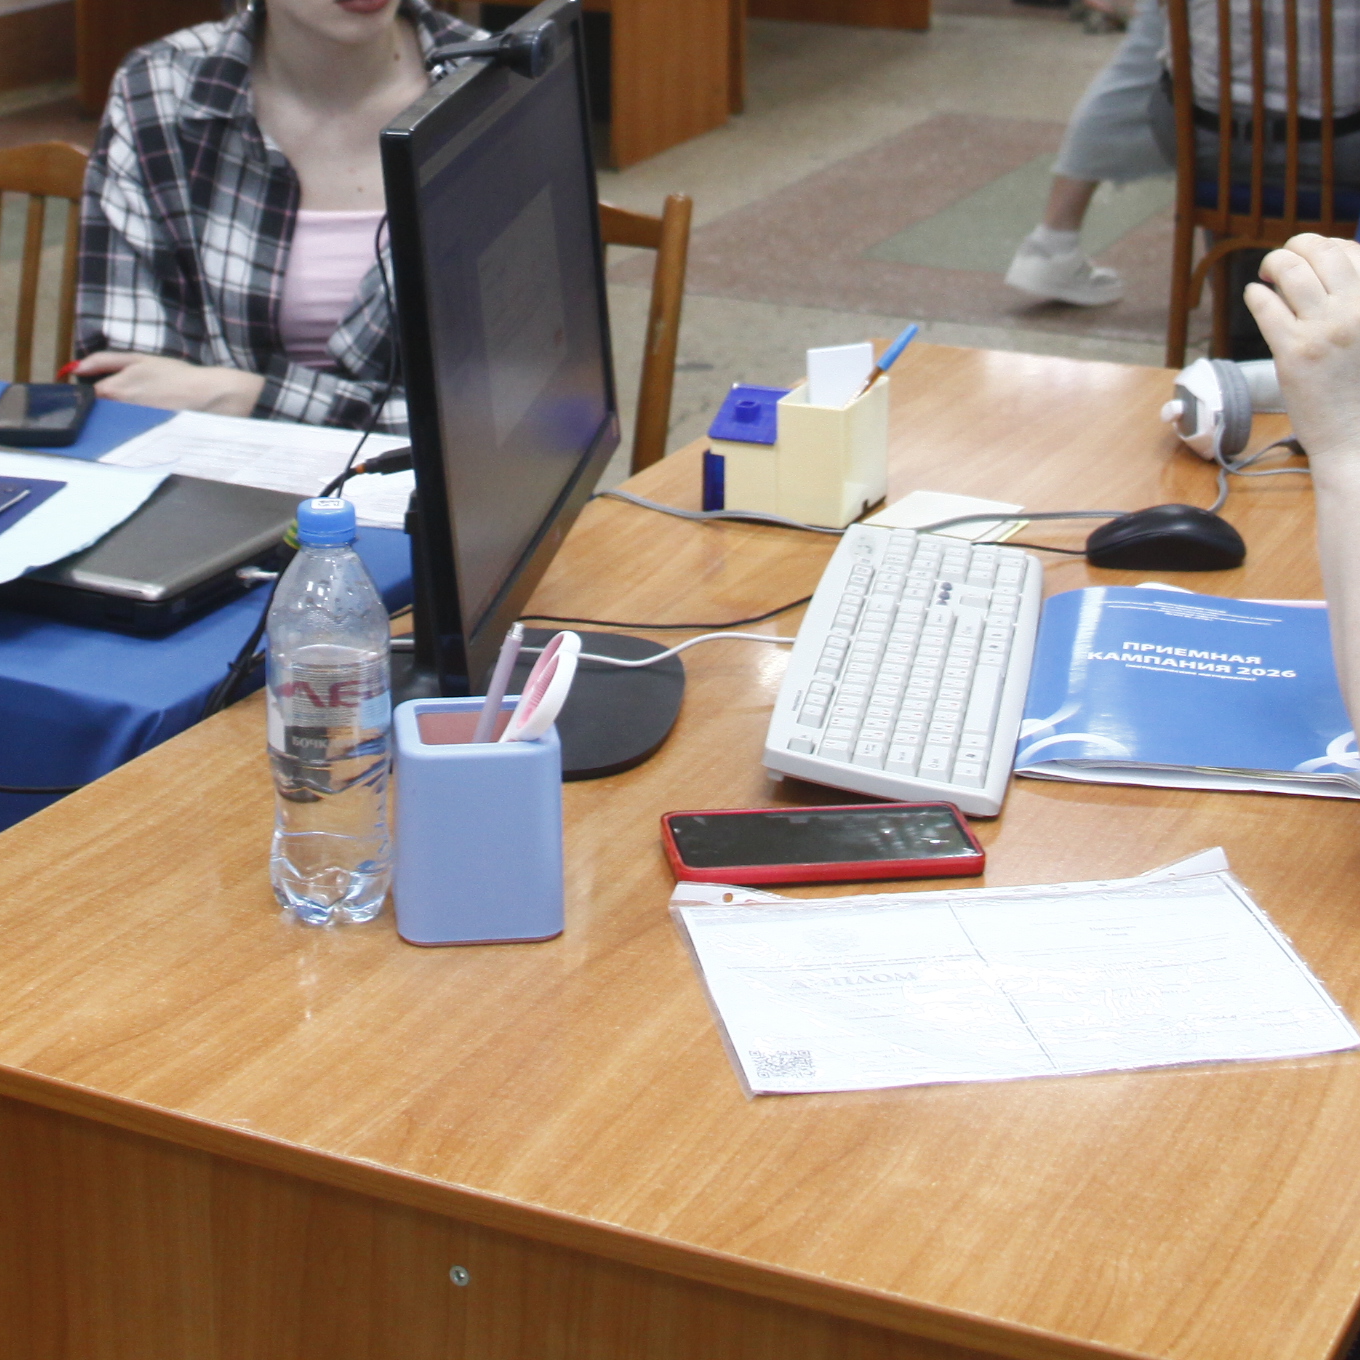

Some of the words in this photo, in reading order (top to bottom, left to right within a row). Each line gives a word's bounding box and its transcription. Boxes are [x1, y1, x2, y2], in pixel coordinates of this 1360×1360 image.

[1087, 651, 1231, 674] КАМПАНИЯ
[1236, 666, 1297, 678] 2026
[1122, 641, 1262, 665] ПРИЕМНАЯ
